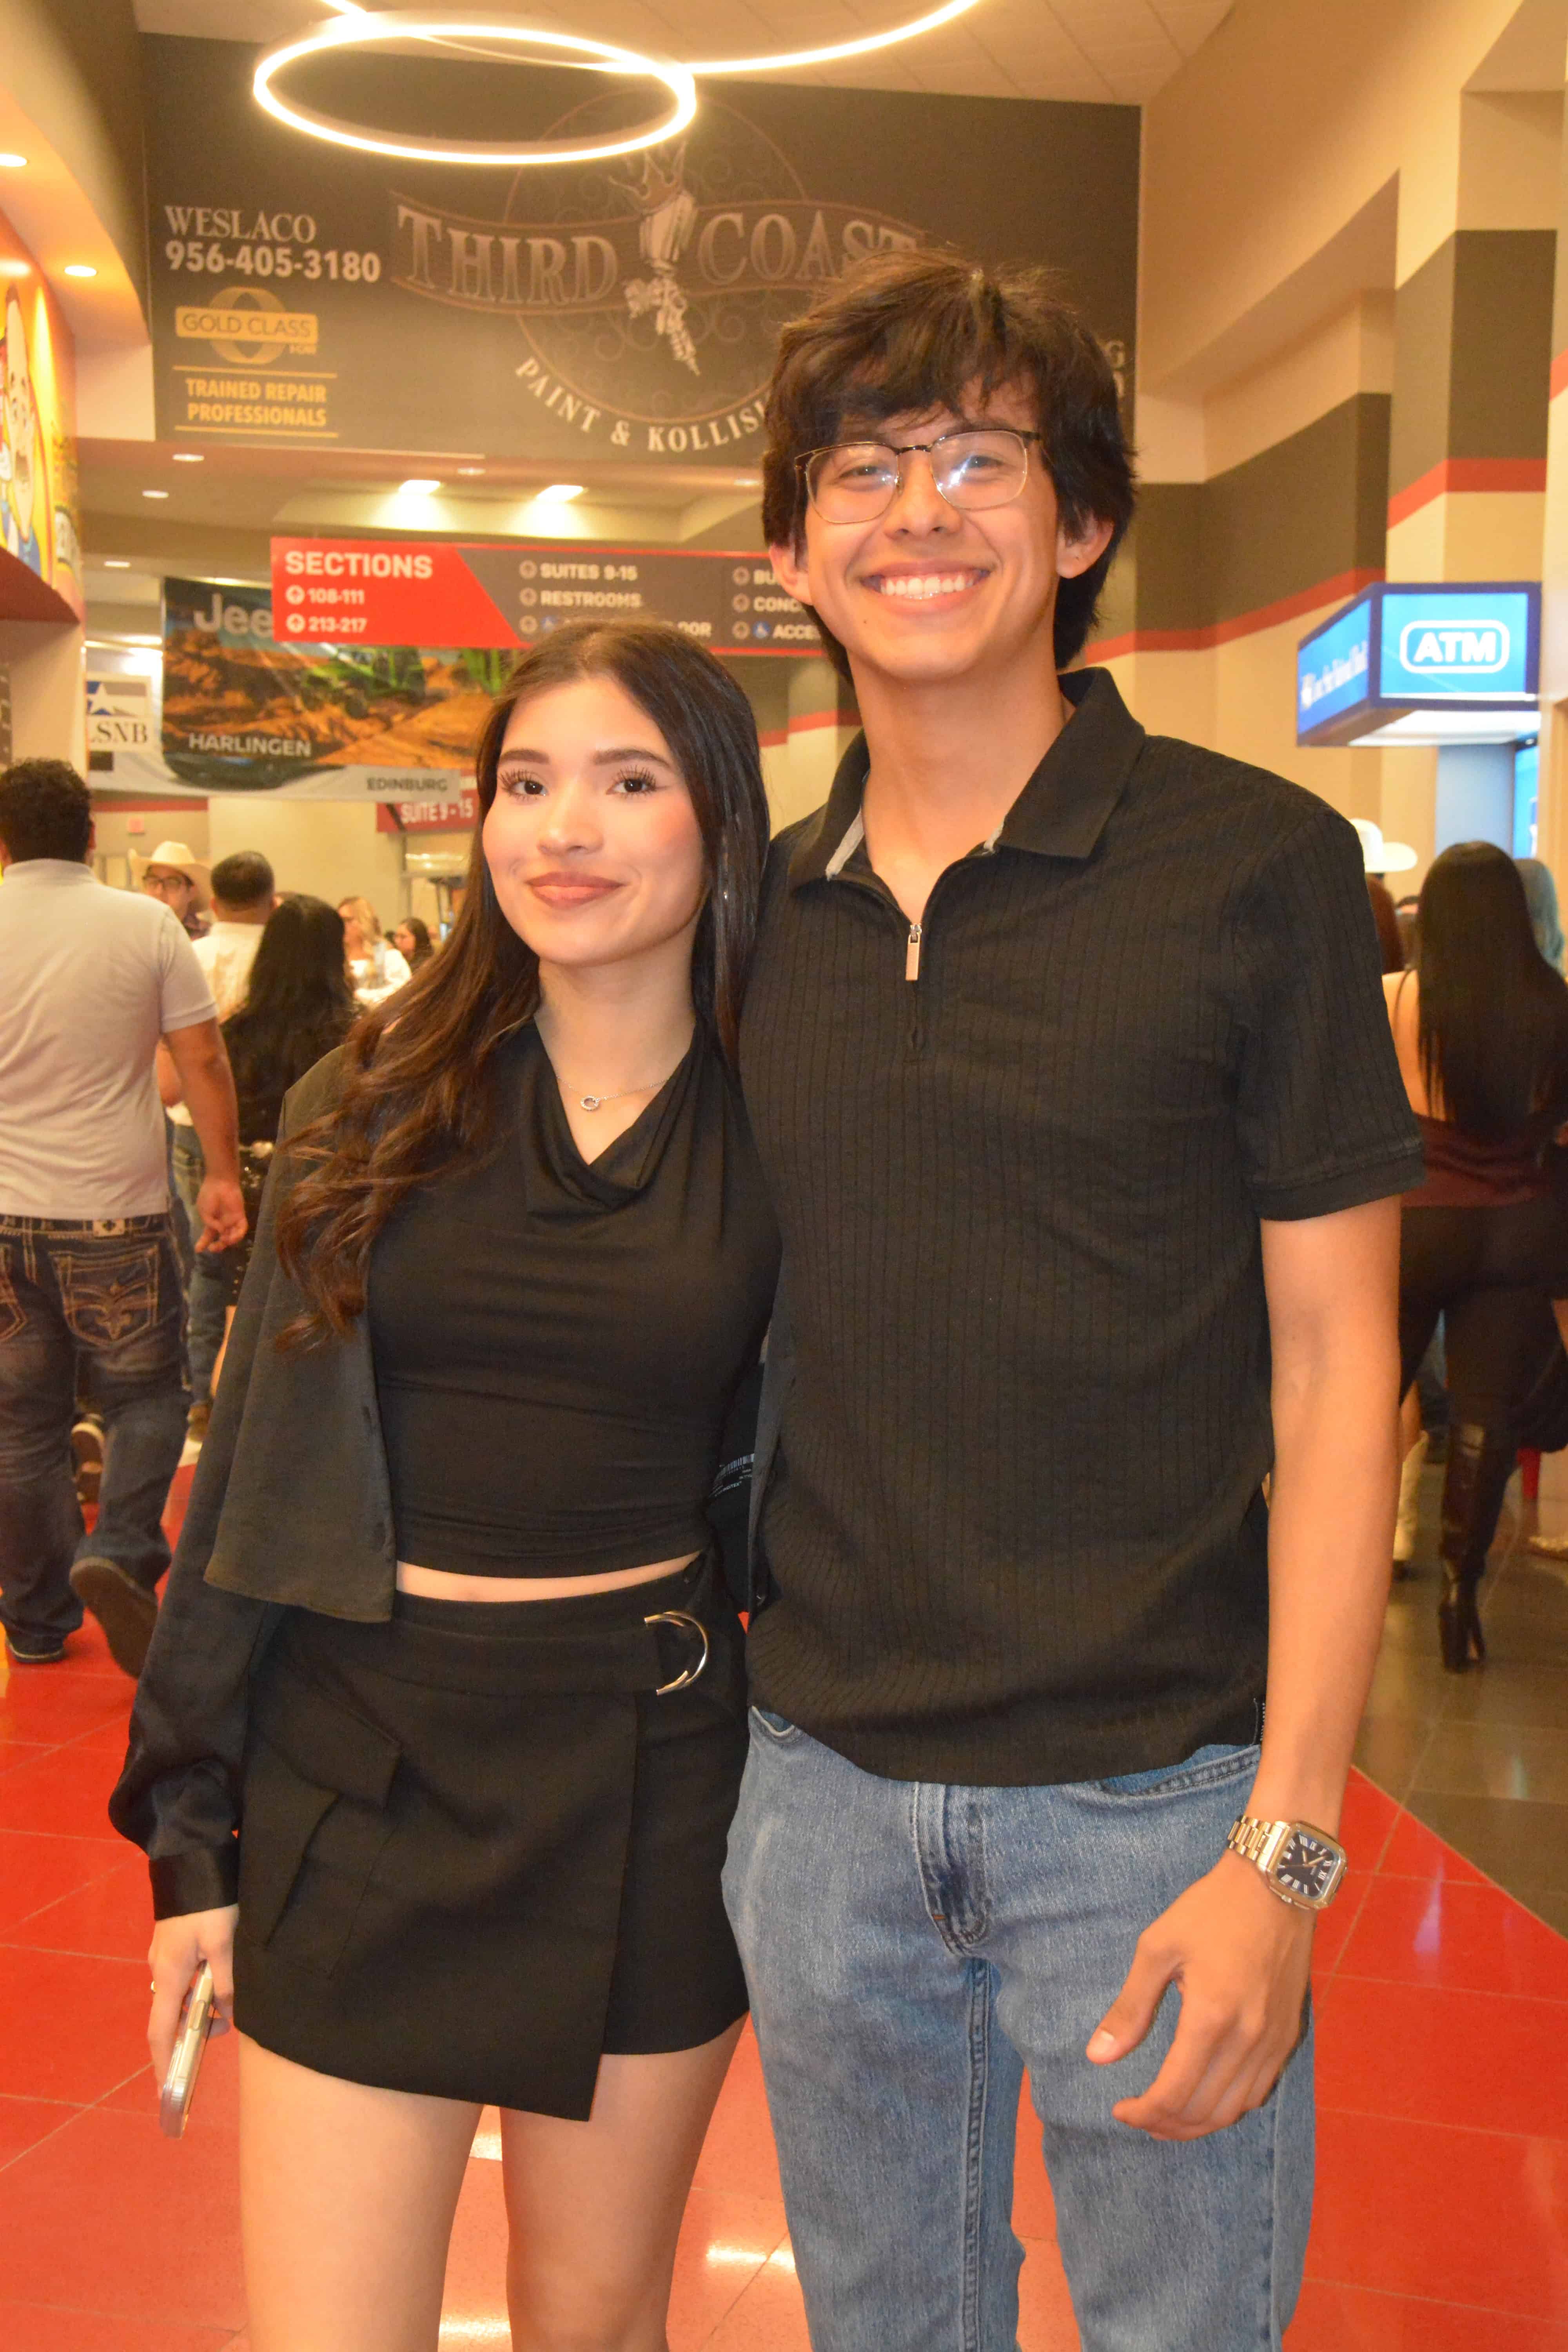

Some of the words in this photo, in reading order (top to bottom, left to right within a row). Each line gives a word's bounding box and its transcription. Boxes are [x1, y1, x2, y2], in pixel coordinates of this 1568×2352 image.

[164, 205, 316, 243] WESLACO
[165, 240, 381, 283] 956-405-3180
[397, 204, 618, 305] THIRD
[182, 314, 242, 334] GOLD
[247, 318, 312, 339] CLASS
[186, 378, 261, 400] TRAINED
[265, 383, 327, 403] REPAIR
[515, 356, 601, 433] PAINT
[610, 419, 631, 446] &
[187, 403, 327, 427] PROFESSIONALS
[284, 551, 433, 579] SECTIONS
[540, 562, 600, 580] SUITES
[604, 564, 638, 581] 9-15
[307, 587, 365, 605] 108-111
[541, 590, 642, 608] RESTROOMS
[753, 596, 803, 613] CONC
[194, 592, 272, 638] Jee
[308, 616, 368, 634] 213-217
[1413, 631, 1497, 662] ATM
[90, 722, 148, 743] SNB
[189, 732, 312, 757] HARLINGEN
[366, 777, 448, 791] EDINBURG
